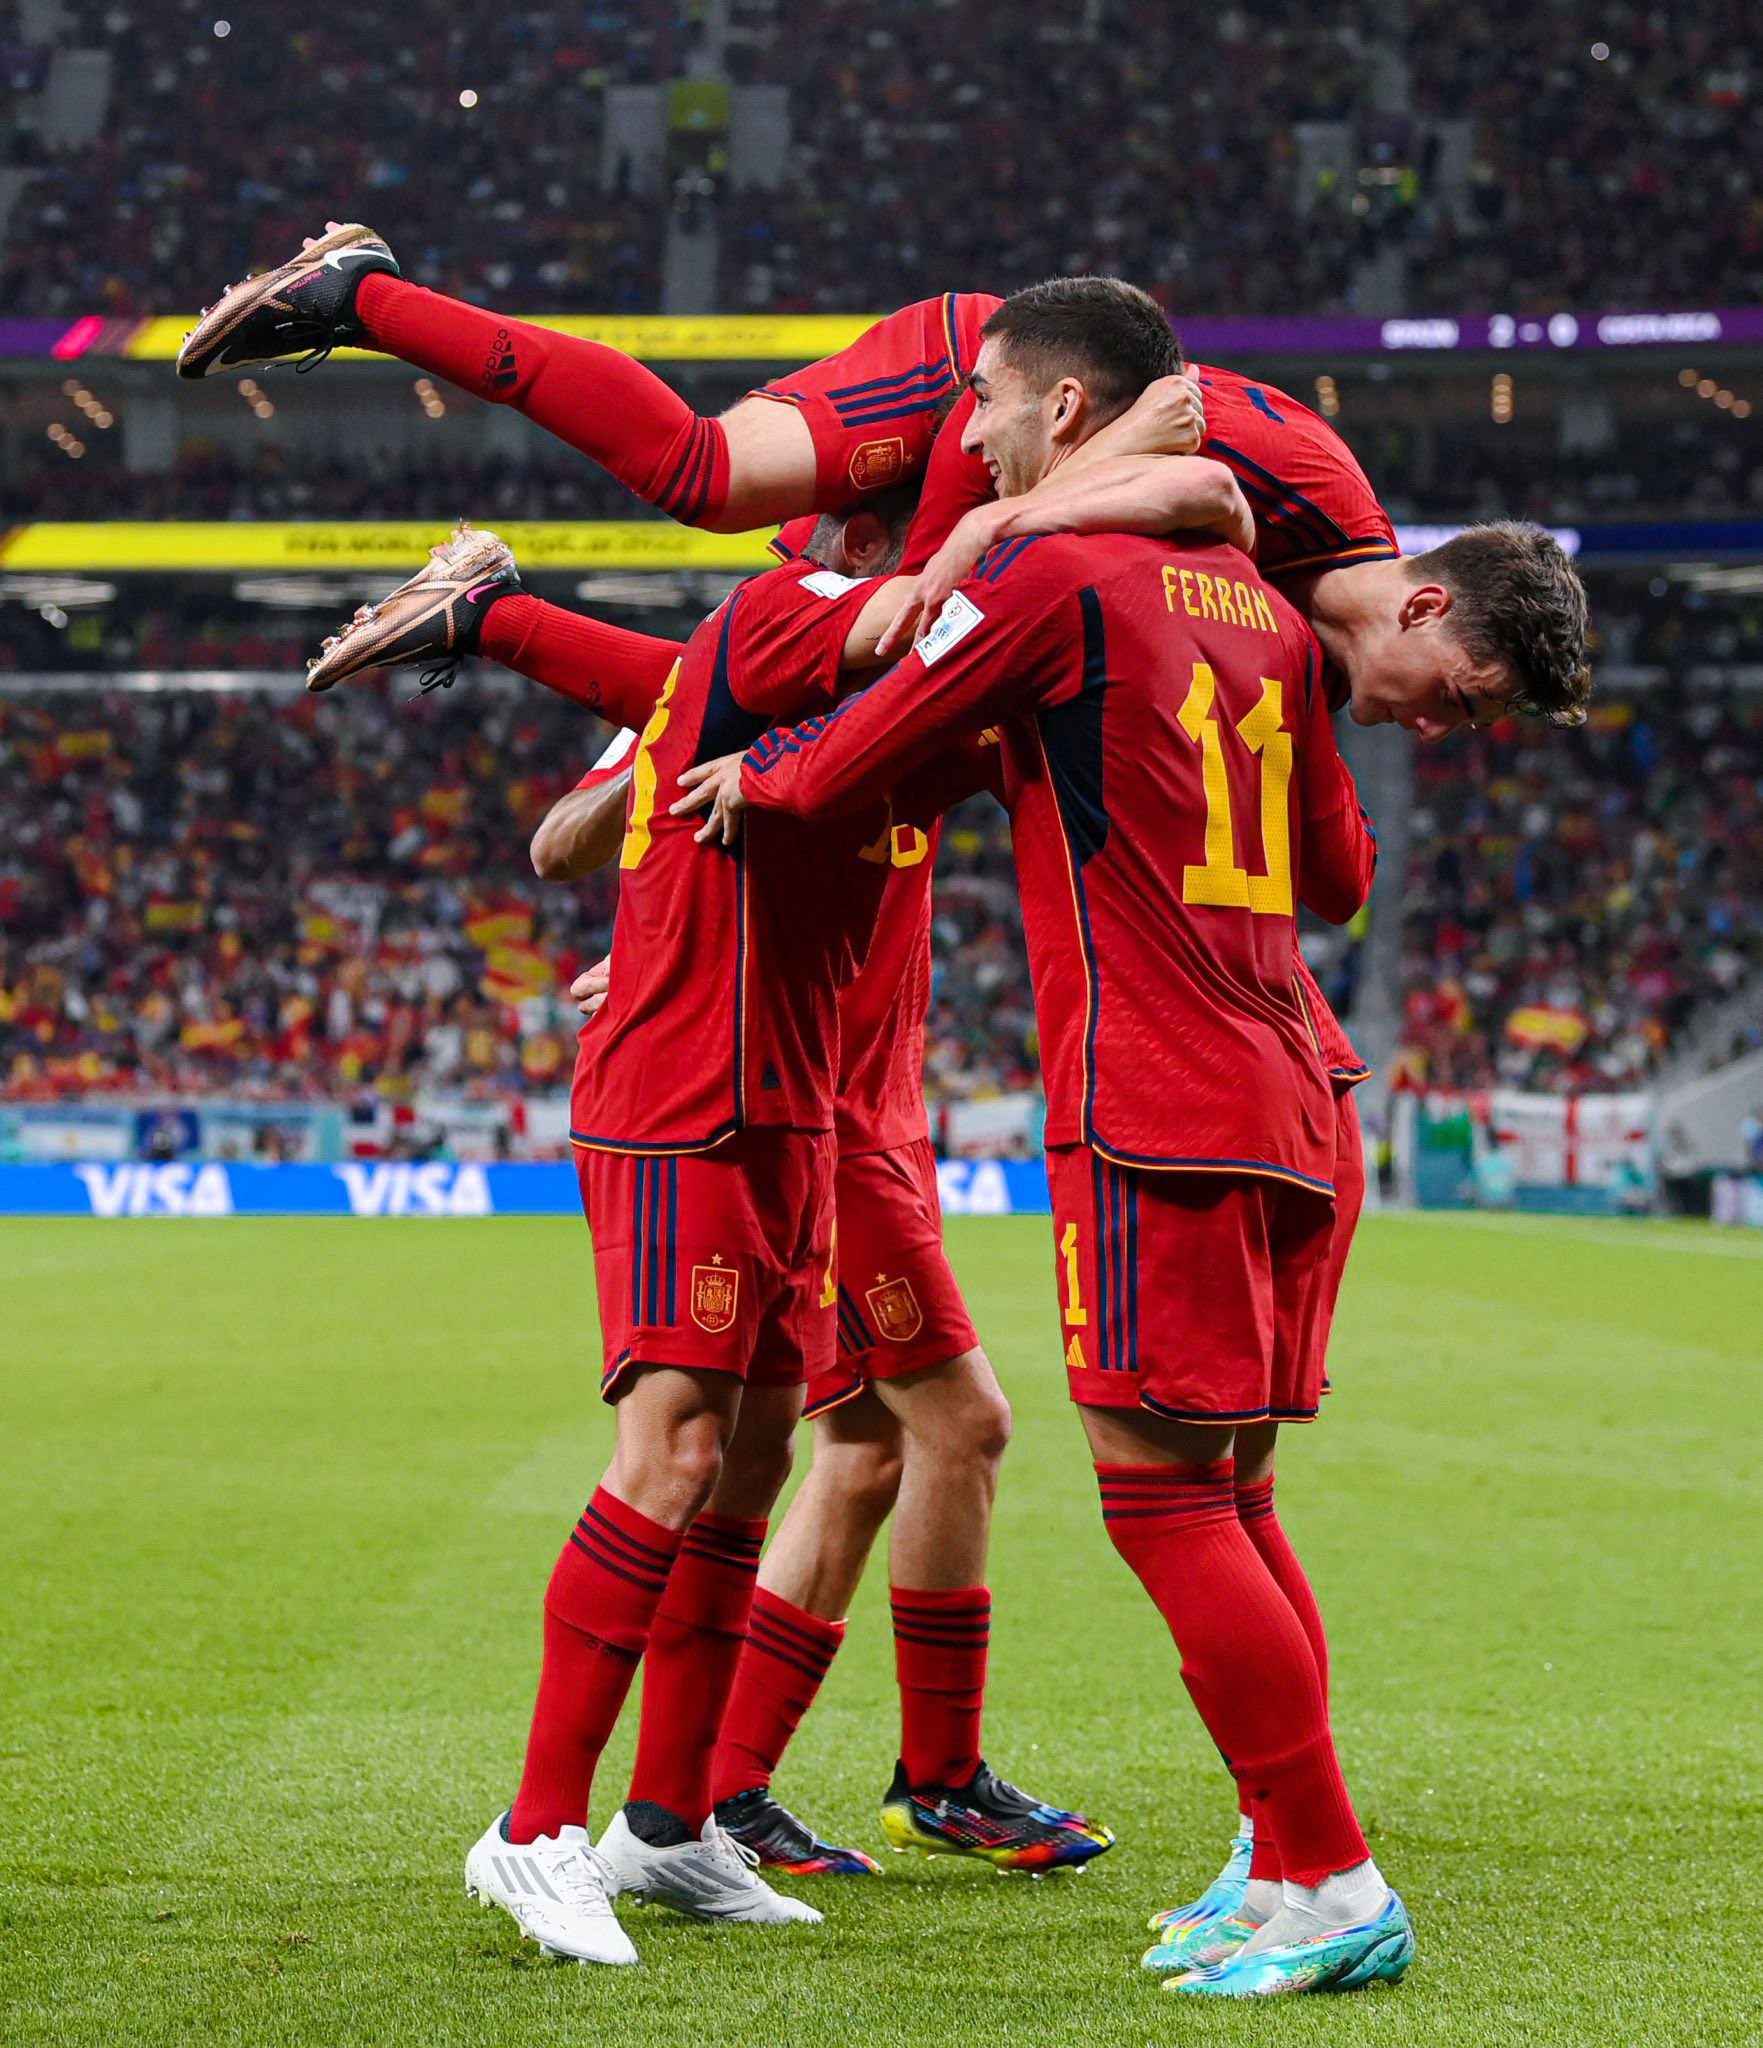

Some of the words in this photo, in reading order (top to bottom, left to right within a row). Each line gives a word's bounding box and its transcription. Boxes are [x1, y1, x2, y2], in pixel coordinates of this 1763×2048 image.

[1161, 565, 1278, 633] FERRAN
[1176, 662, 1293, 917] 11
[74, 1161, 235, 1217] VISA
[331, 1161, 493, 1217] VISA
